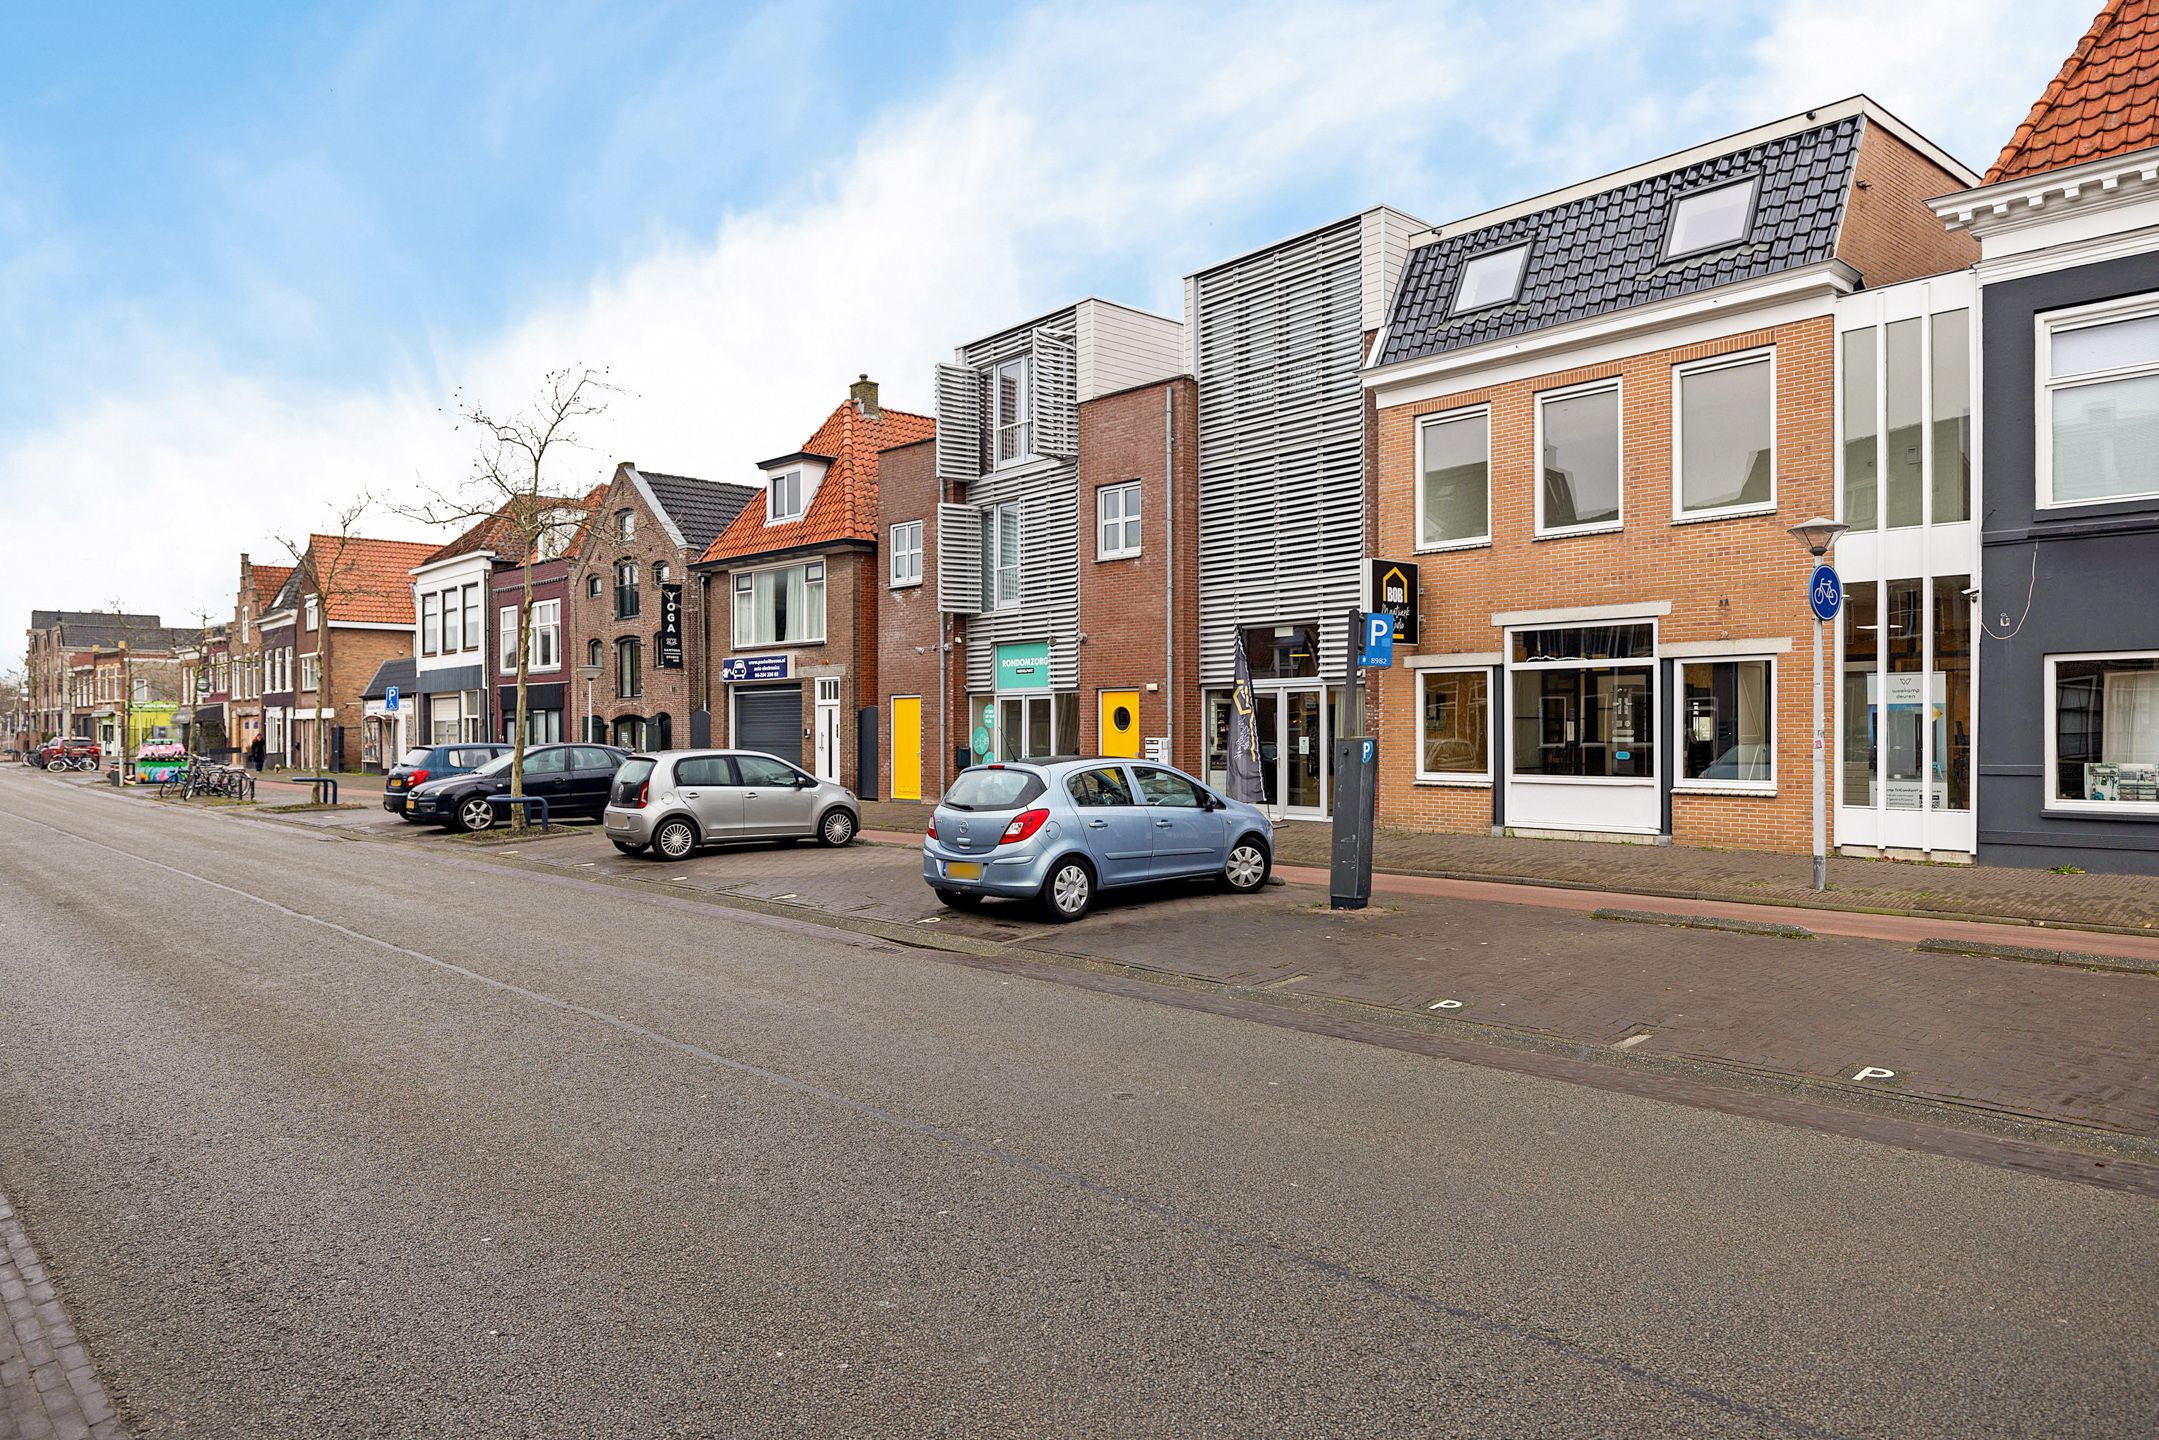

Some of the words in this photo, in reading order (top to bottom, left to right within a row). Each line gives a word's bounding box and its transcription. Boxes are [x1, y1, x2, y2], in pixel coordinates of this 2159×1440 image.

[1387, 586, 1404, 603] BOB
[667, 591, 676, 633] YOGA
[1370, 619, 1388, 647] P
[1002, 656, 1049, 668] RONDOMZORG
[1370, 657, 1387, 665] 8982
[389, 689, 397, 701] P
[1363, 742, 1370, 759] P
[1428, 999, 1463, 1010] P
[1852, 1066, 1895, 1081] P
